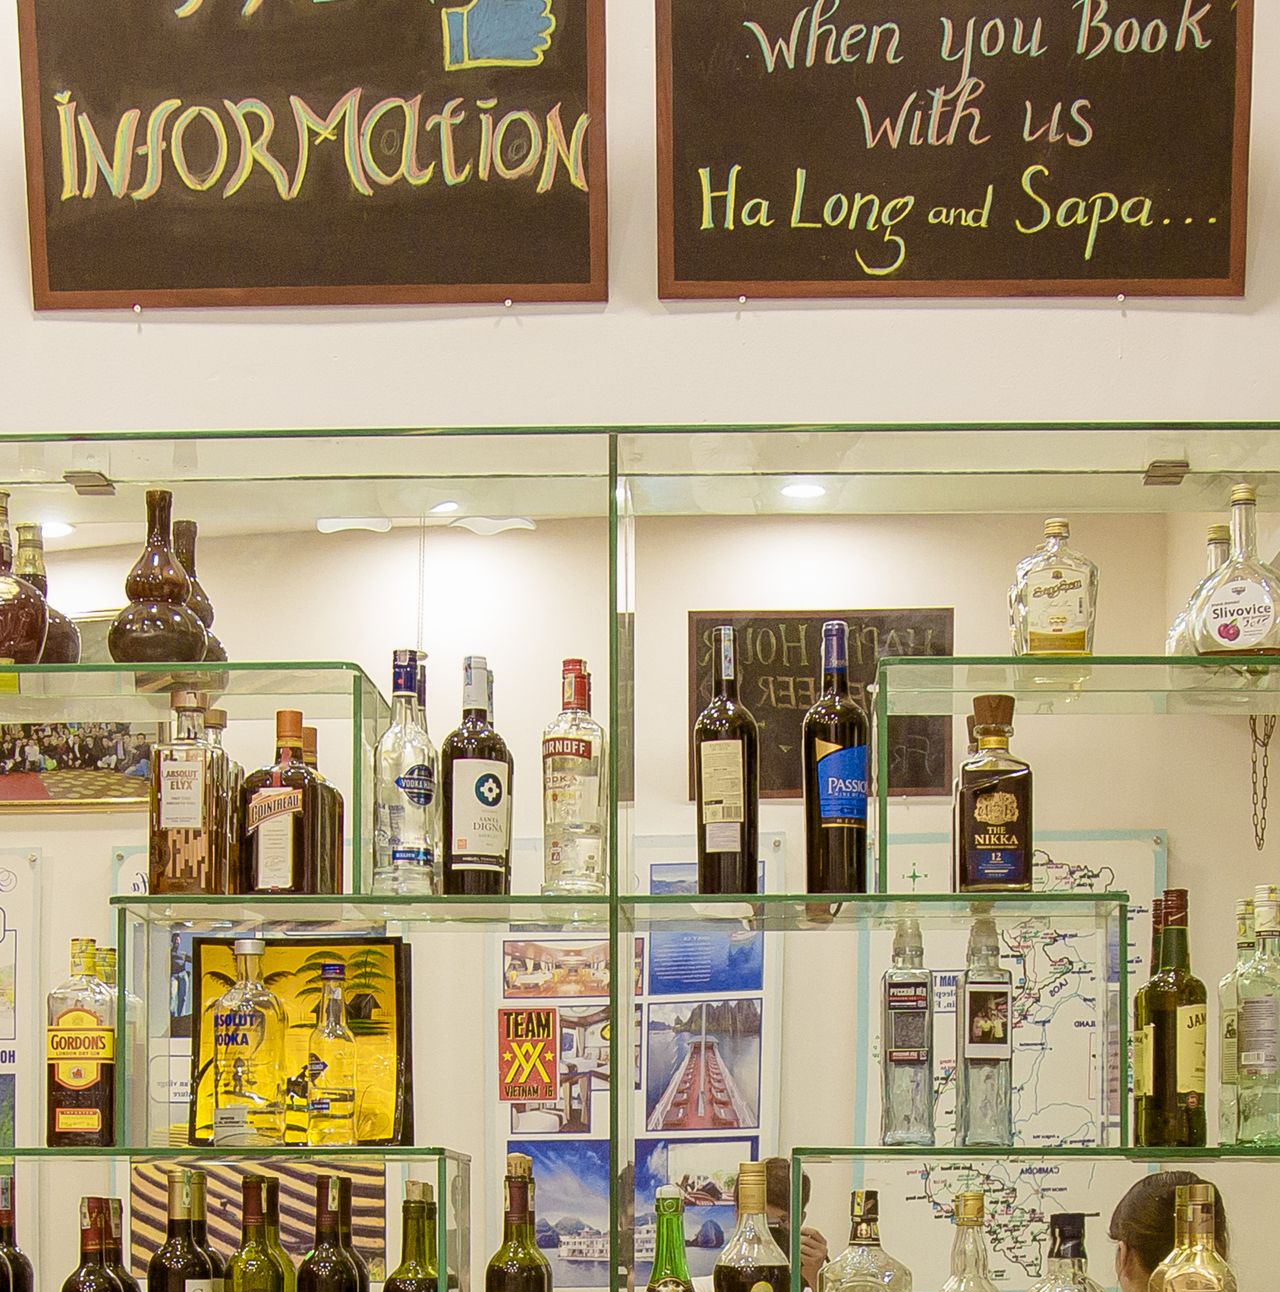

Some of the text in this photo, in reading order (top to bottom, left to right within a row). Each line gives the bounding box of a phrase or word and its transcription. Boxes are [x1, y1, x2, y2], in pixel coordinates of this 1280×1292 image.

[940, 16, 1048, 92] you
[1024, 99, 1093, 147] us
[699, 165, 773, 231] Ha
[791, 168, 913, 276] Long
[929, 185, 993, 228] and
[1212, 604, 1272, 620] Slivovice
[543, 740, 586, 754] IRNOFF
[166, 770, 198, 779] ABSOLUT
[545, 775, 577, 784] ODKA
[170, 779, 193, 791] ELYX
[828, 777, 868, 793] PASSIO
[252, 793, 299, 823] COINTREAU
[473, 822, 503, 833] DIGNA
[987, 826, 1006, 834] THE
[974, 834, 1019, 845] NIKKA
[991, 852, 1002, 861] 12
[503, 1012, 552, 1040] TEAM
[51, 1034, 106, 1050] GORDON'S
[216, 1034, 249, 1046] ODKA
[505, 1085, 539, 1098] VIETNAM
